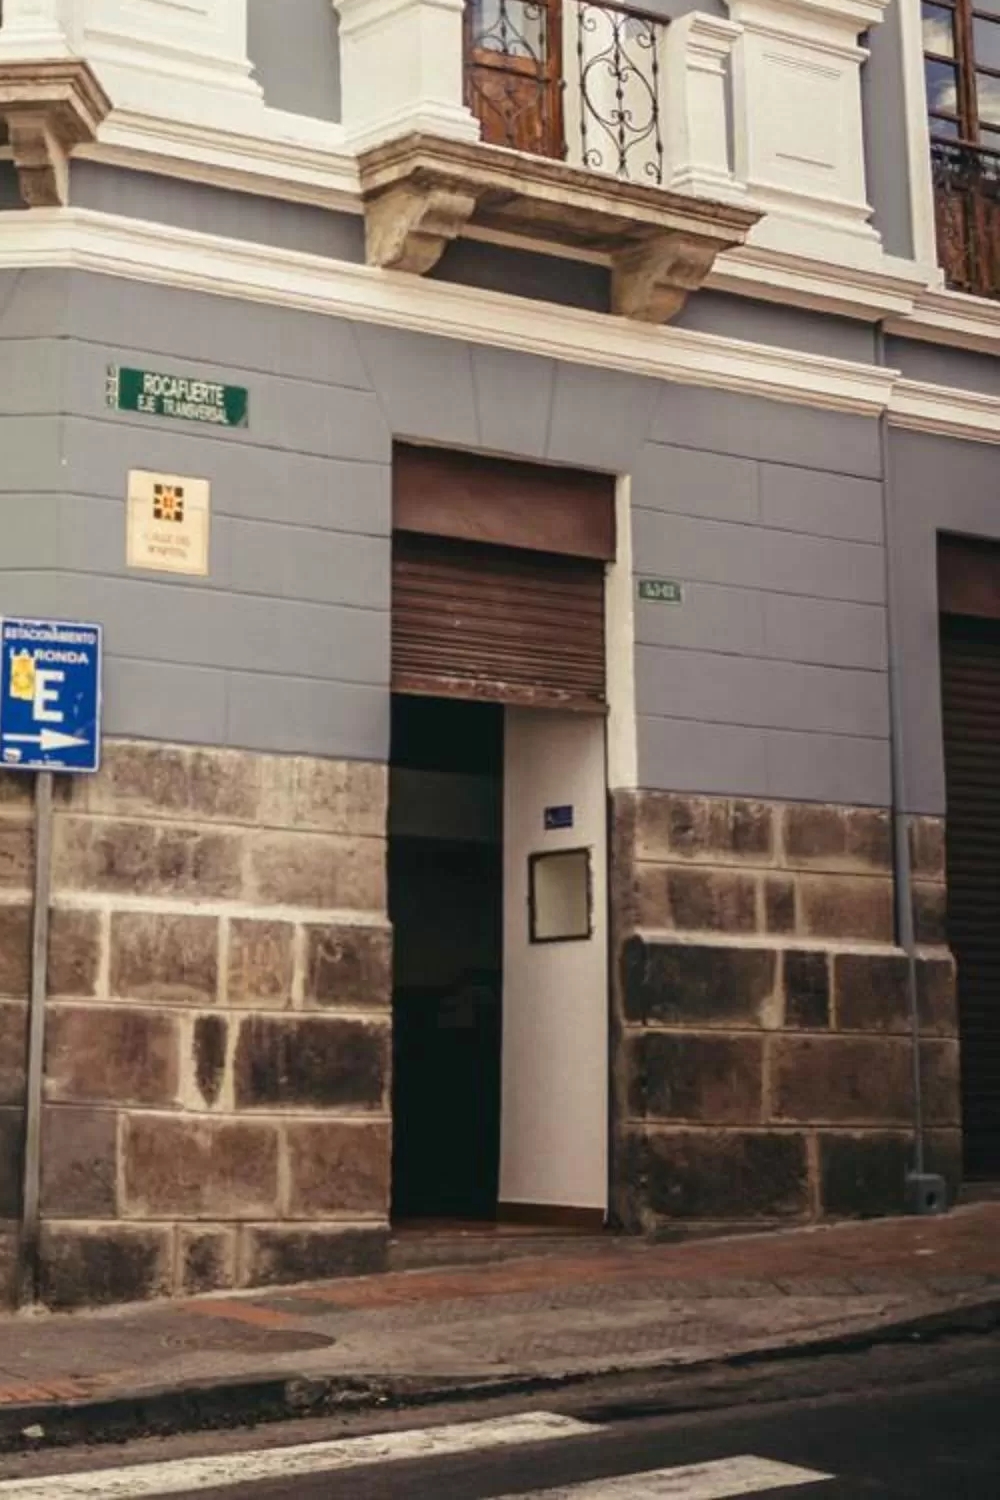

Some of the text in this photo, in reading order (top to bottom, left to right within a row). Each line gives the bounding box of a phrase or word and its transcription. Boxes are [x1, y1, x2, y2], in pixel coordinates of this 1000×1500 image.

[142, 372, 225, 406] ROCAFUERTE
[33, 648, 89, 665] RONDA
[32, 669, 66, 723] E
